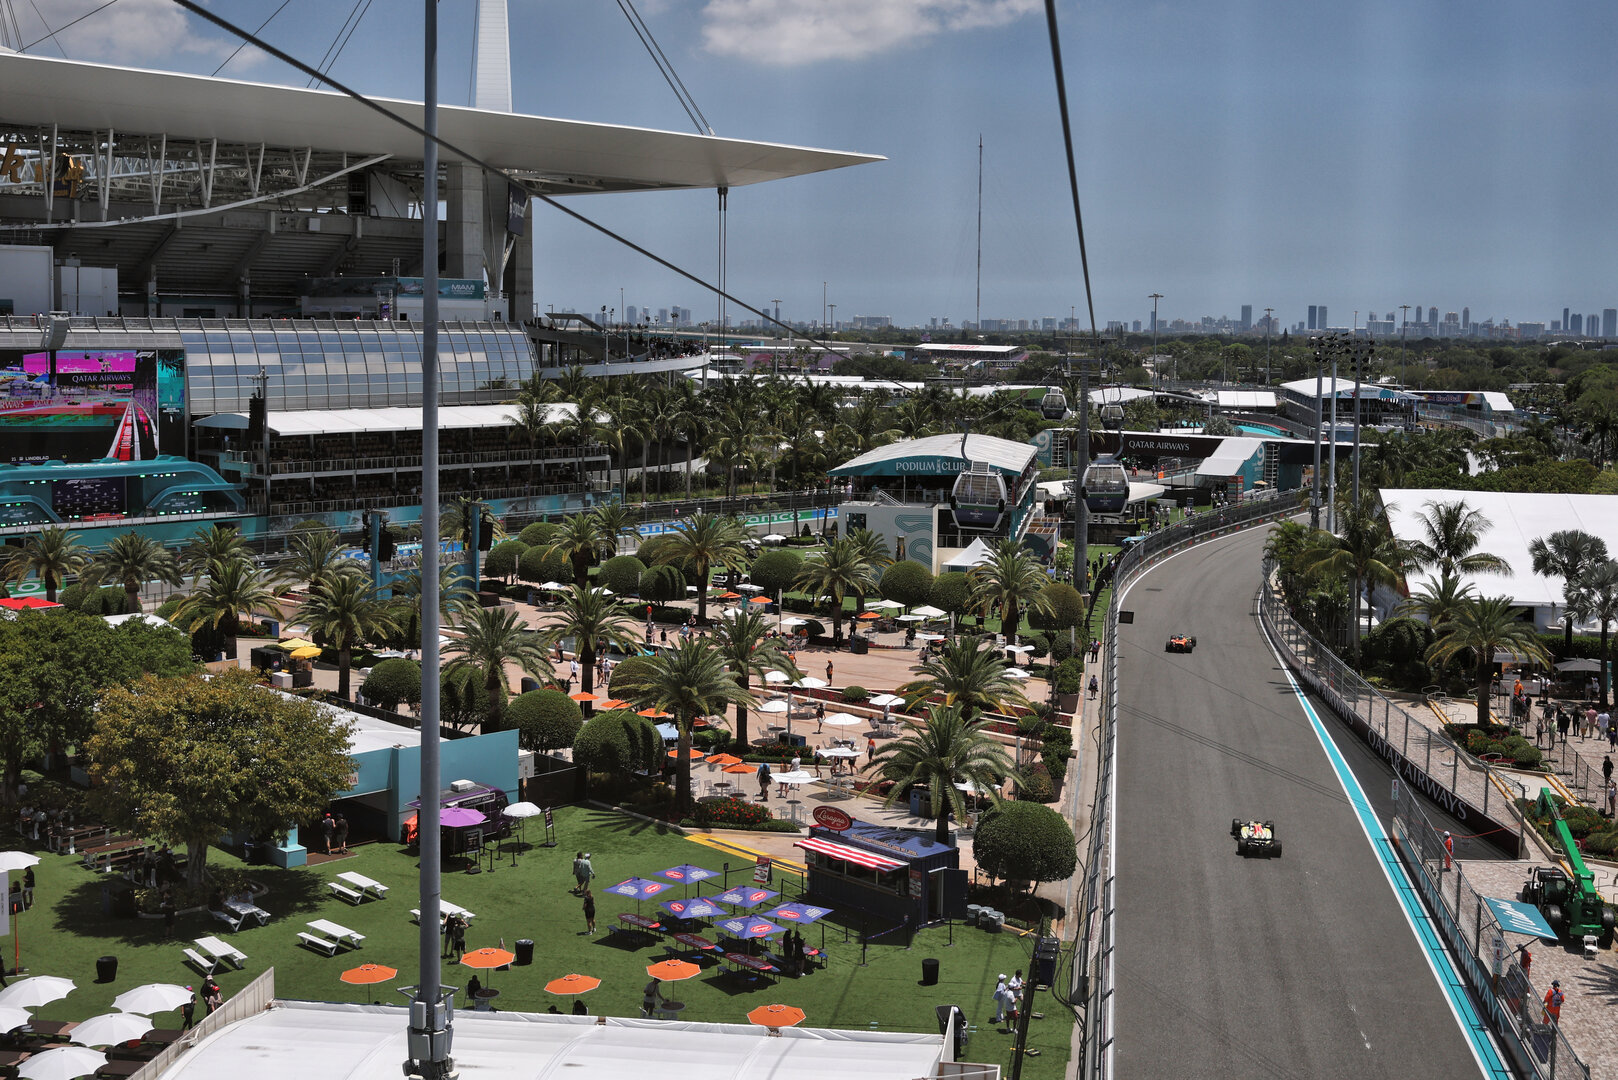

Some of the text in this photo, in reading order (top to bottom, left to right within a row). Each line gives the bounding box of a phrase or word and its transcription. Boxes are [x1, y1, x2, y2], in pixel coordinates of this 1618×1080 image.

[72, 374, 131, 383] QATAR AIRWAYS
[1036, 432, 1050, 452] 9
[1128, 440, 1190, 451] QATAR AIRWAYS
[1256, 444, 1265, 466] 9
[896, 461, 935, 471] PODIUM
[1321, 686, 1354, 725] AIRWAYS
[1367, 729, 1467, 820] QATAR AIRWAYS
[1420, 870, 1505, 1038] QATAR AIRWAYS
